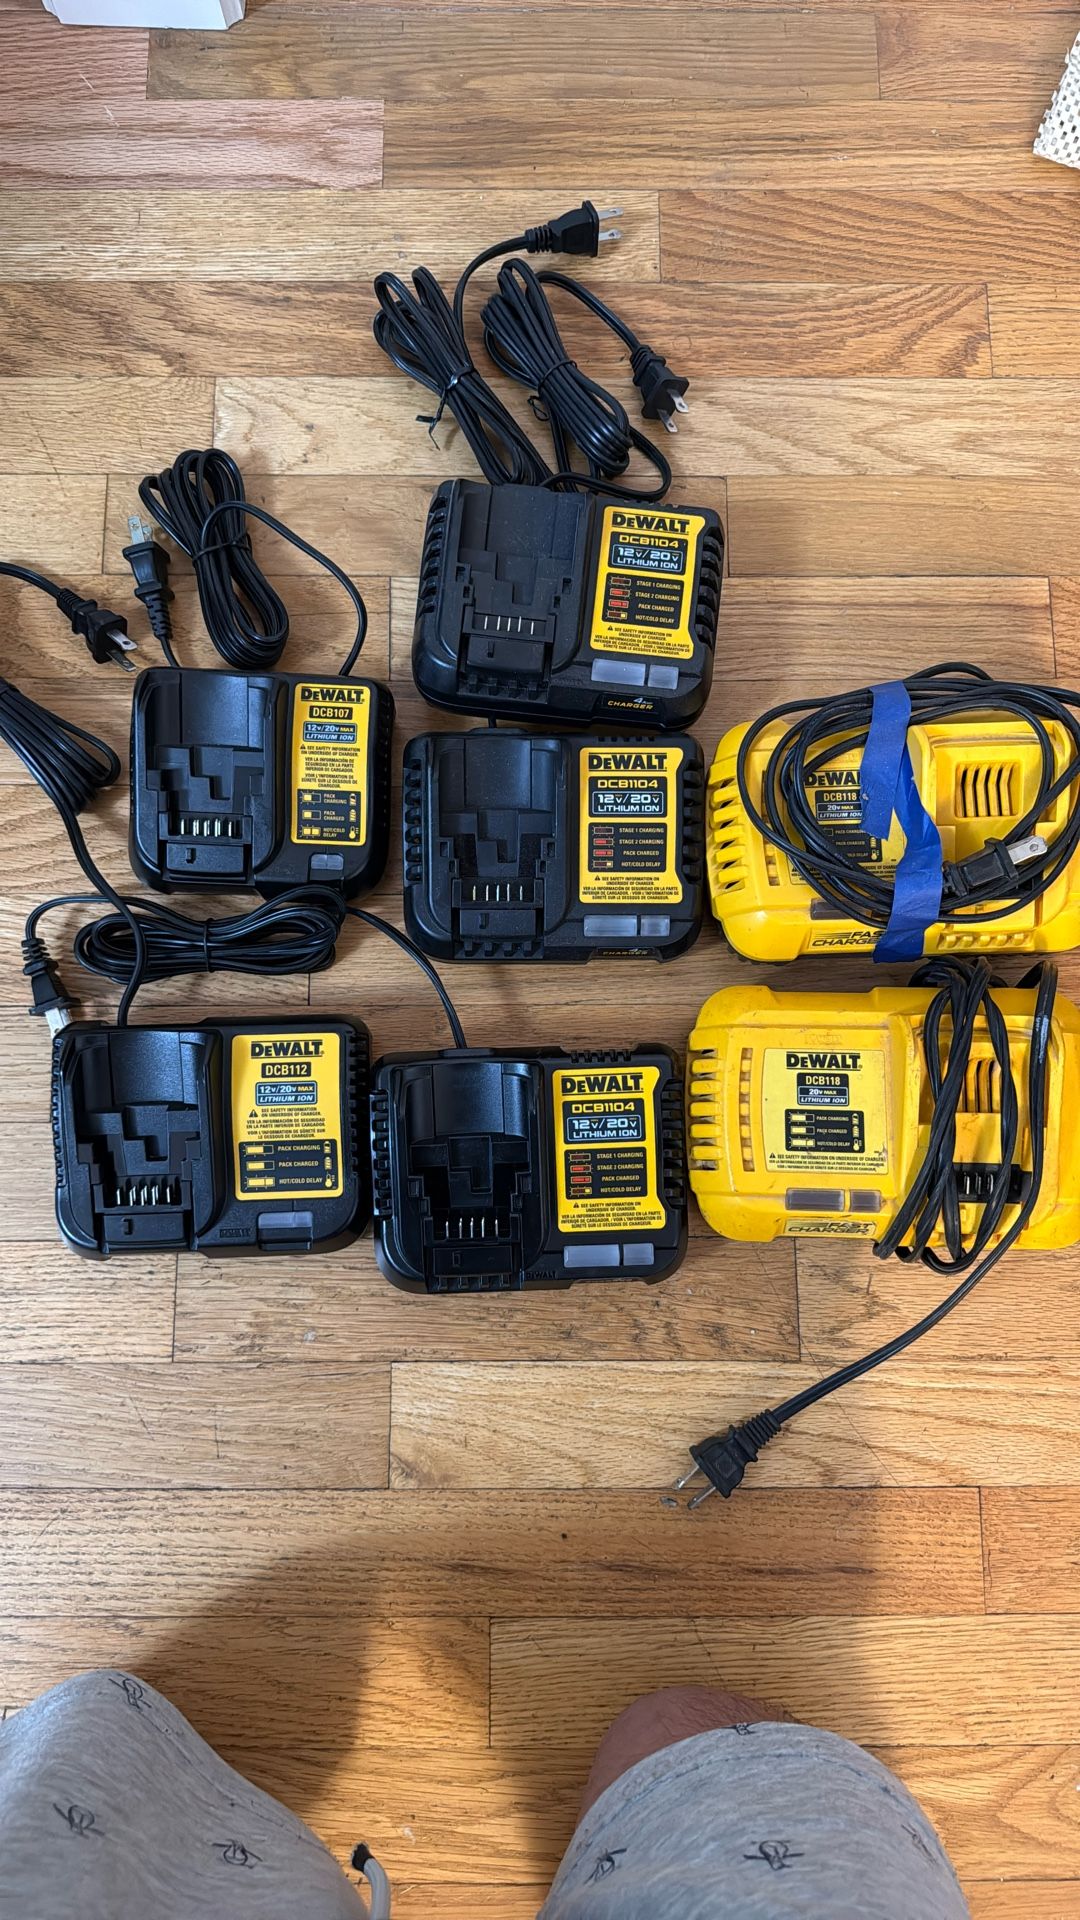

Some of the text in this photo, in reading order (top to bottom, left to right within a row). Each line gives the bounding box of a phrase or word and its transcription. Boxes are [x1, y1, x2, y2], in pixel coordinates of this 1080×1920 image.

[612, 513, 690, 534] DEWALT
[620, 534, 678, 548] DCB1104
[618, 557, 678, 569] LITHIUM ION
[301, 688, 364, 702] DEWALT
[608, 700, 654, 710] CHARGER
[313, 707, 350, 718] DCB107
[588, 754, 667, 770] DEWALT
[598, 780, 658, 788] DCB1104
[824, 792, 856, 801] DCB118
[251, 1042, 322, 1057] DEWALT
[786, 1054, 860, 1068] DEWALT
[266, 1064, 307, 1076] DCB112
[561, 1075, 643, 1093] DEWALT
[806, 1076, 840, 1085] DCB118
[572, 1102, 635, 1113] DCB1104
[573, 1130, 616, 1138] LITHIUM
